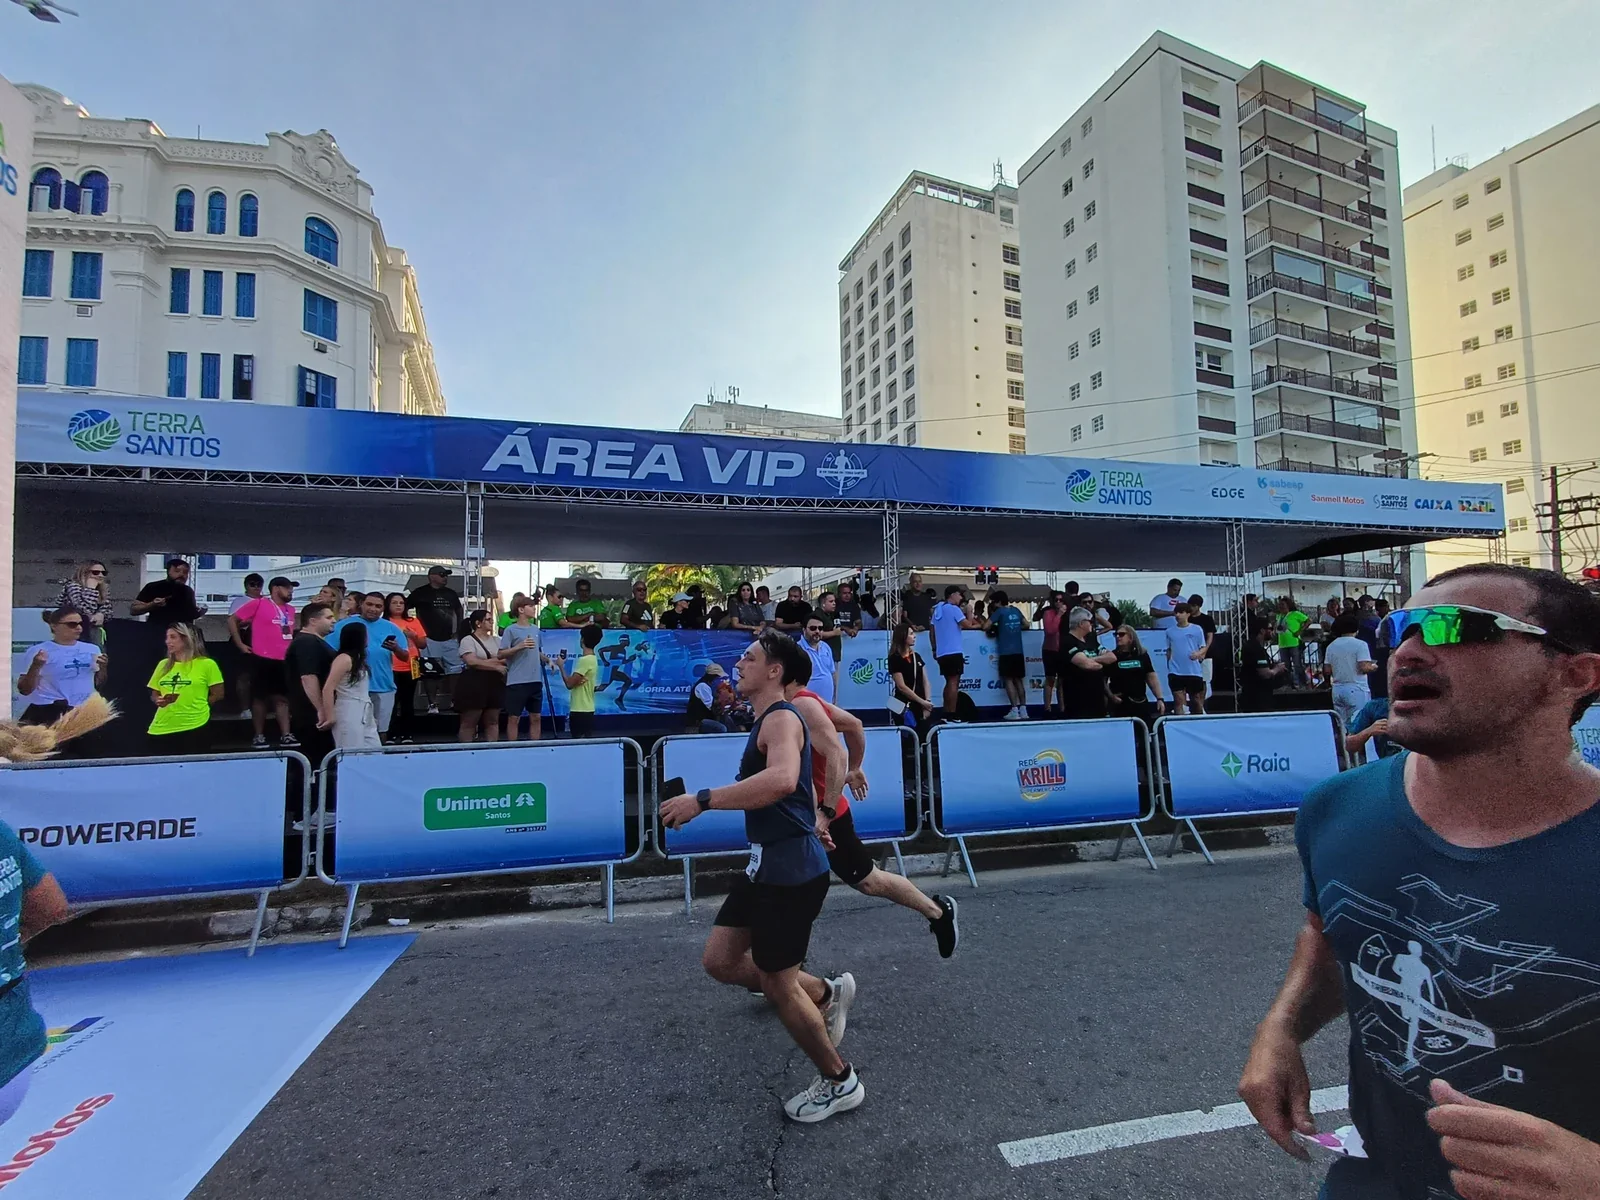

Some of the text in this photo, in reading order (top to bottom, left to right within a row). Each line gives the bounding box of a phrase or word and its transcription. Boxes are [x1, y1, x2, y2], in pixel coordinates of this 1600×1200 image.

[127, 411, 206, 434] TERRA
[125, 434, 221, 458] SANTOS
[481, 427, 806, 487] ÁREA VIP
[1100, 470, 1144, 488] TERRA
[1269, 479, 1304, 490] sabesp
[1098, 488, 1152, 506] SANTOS
[1211, 487, 1245, 499] EDGE
[1342, 496, 1365, 505] Motos
[1380, 500, 1408, 508] SANTOS
[1414, 498, 1453, 511] CAIXA
[1457, 499, 1496, 513] BRASIL
[1018, 758, 1038, 767] REDE
[1247, 752, 1291, 774] Raia
[1018, 763, 1065, 787] KRILL
[436, 794, 512, 812] Unimed
[485, 812, 511, 820] Santos
[19, 817, 197, 848] POWERADE
